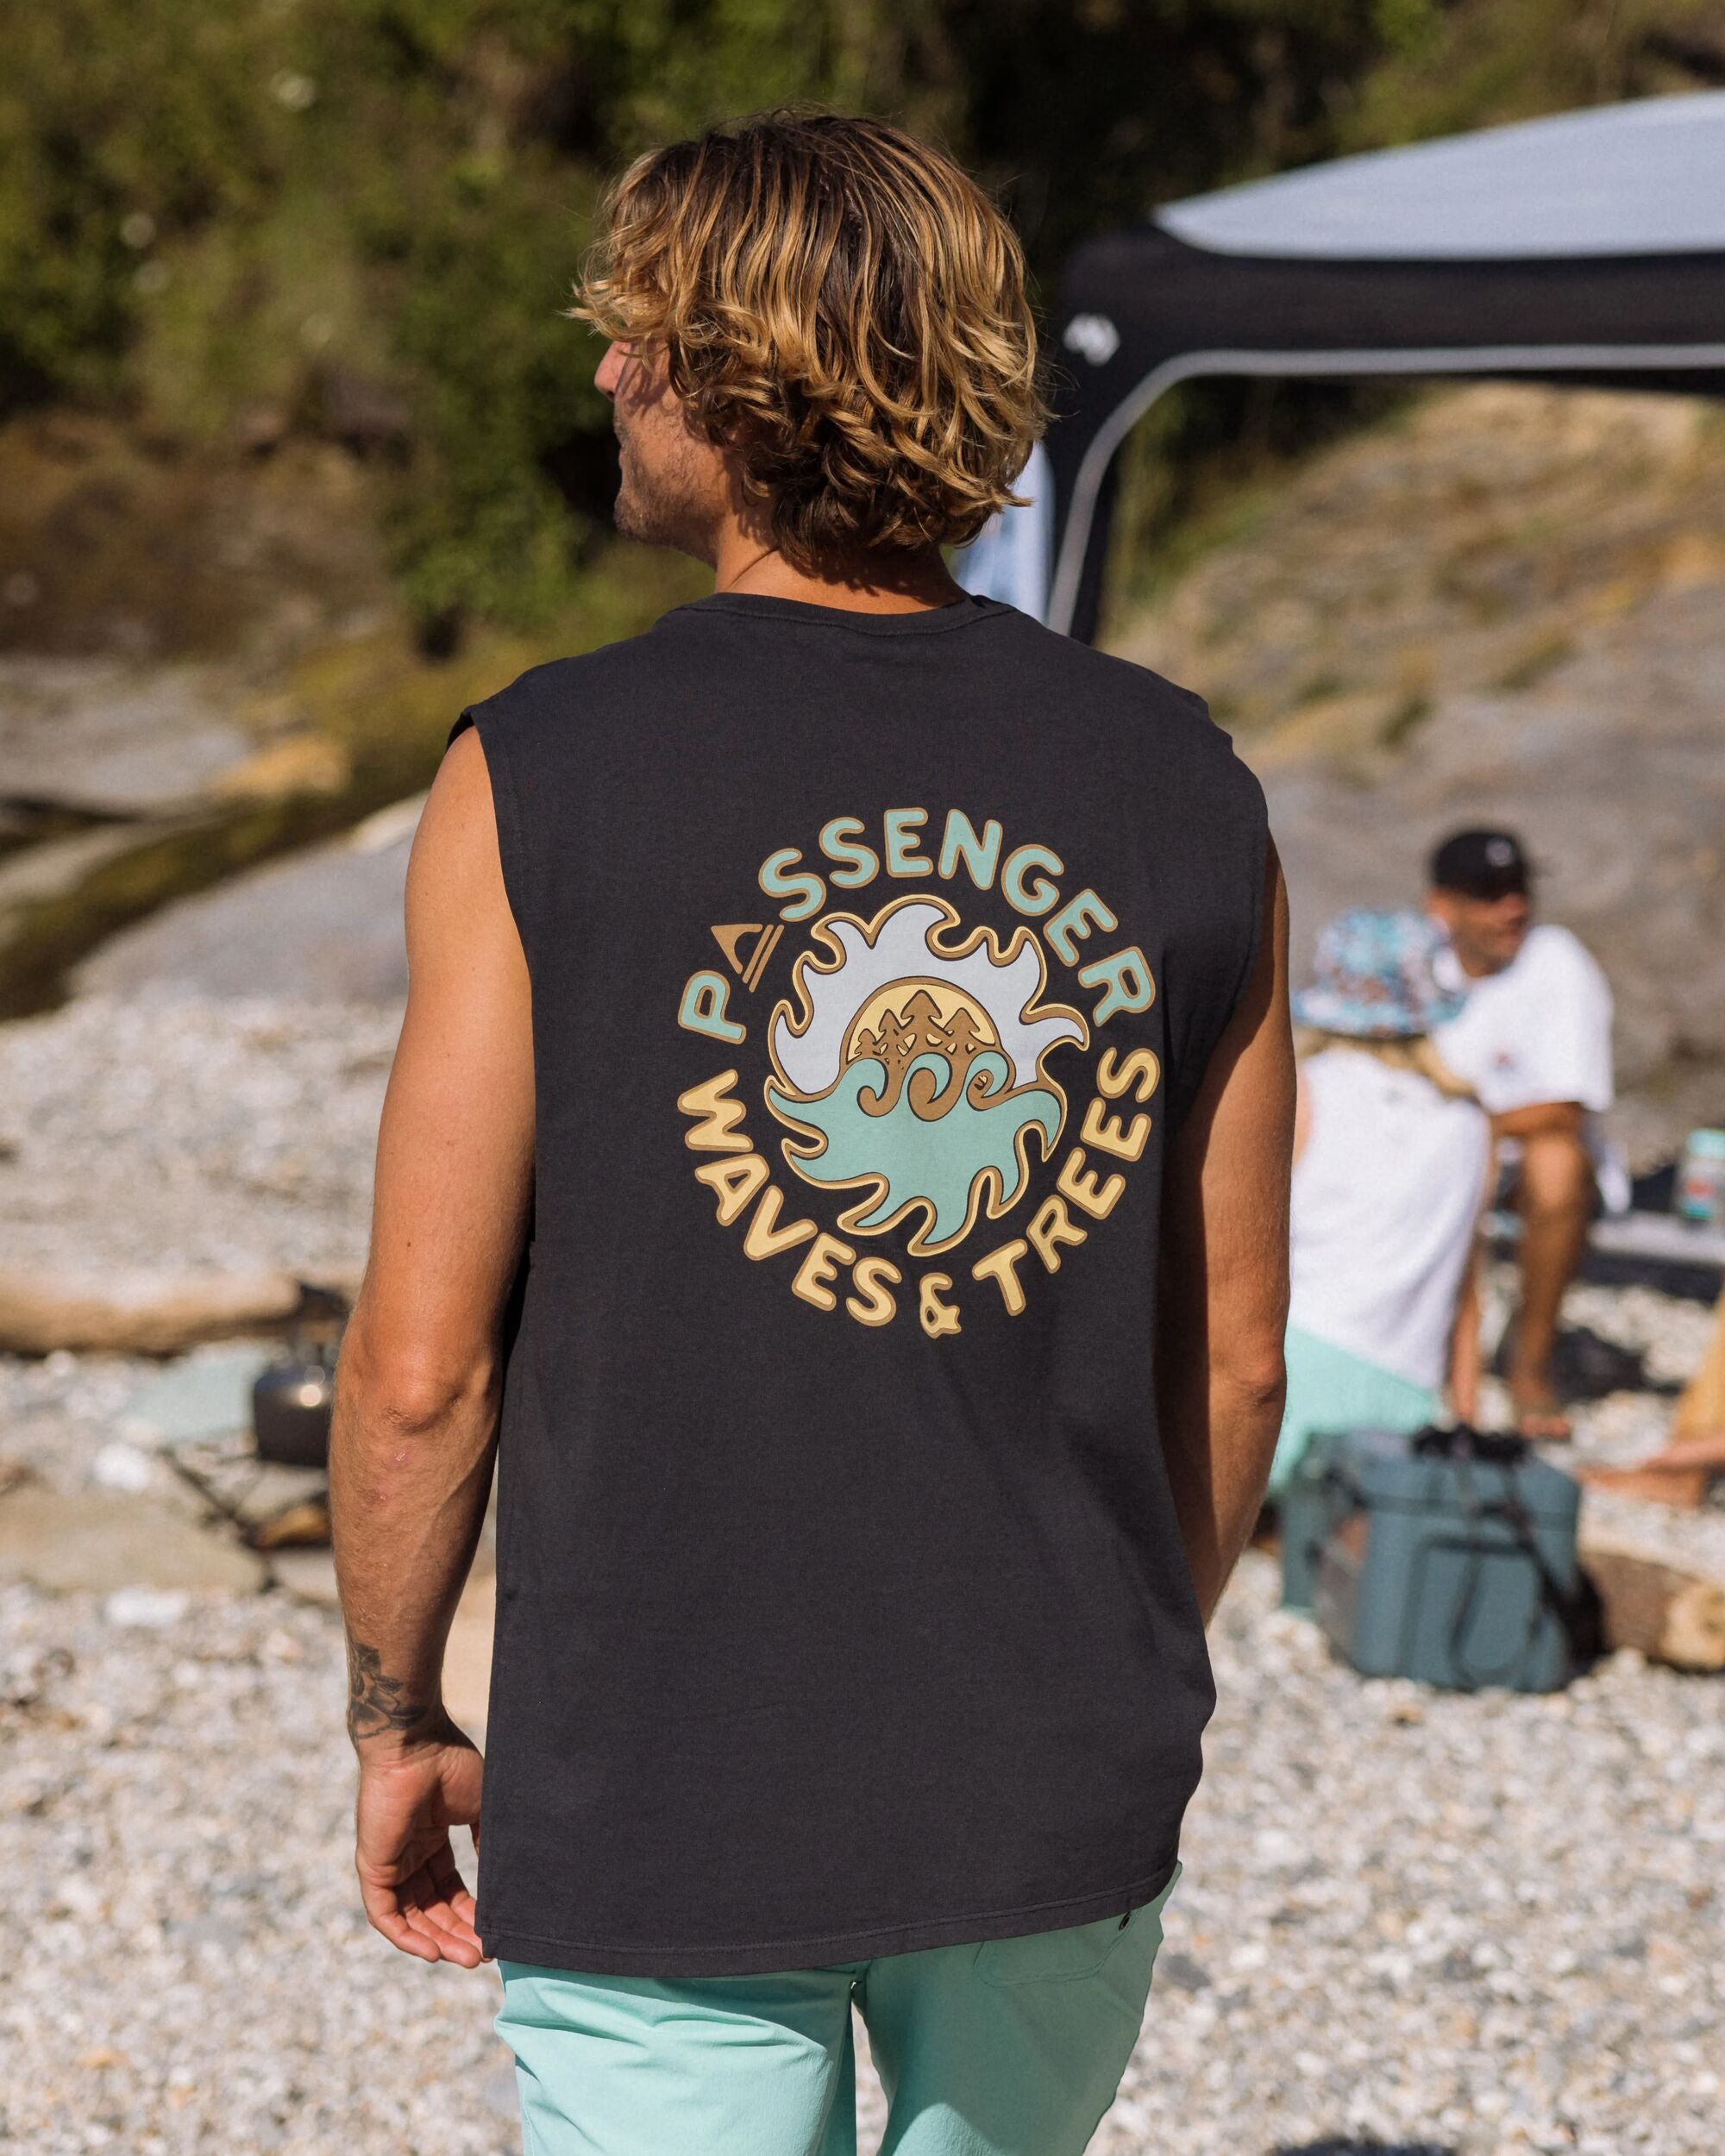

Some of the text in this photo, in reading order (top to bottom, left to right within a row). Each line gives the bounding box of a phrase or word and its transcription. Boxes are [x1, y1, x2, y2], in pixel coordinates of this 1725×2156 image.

[678, 807, 1156, 1044] PASSENGER
[678, 1047, 1161, 1338] WAVES & TREES
